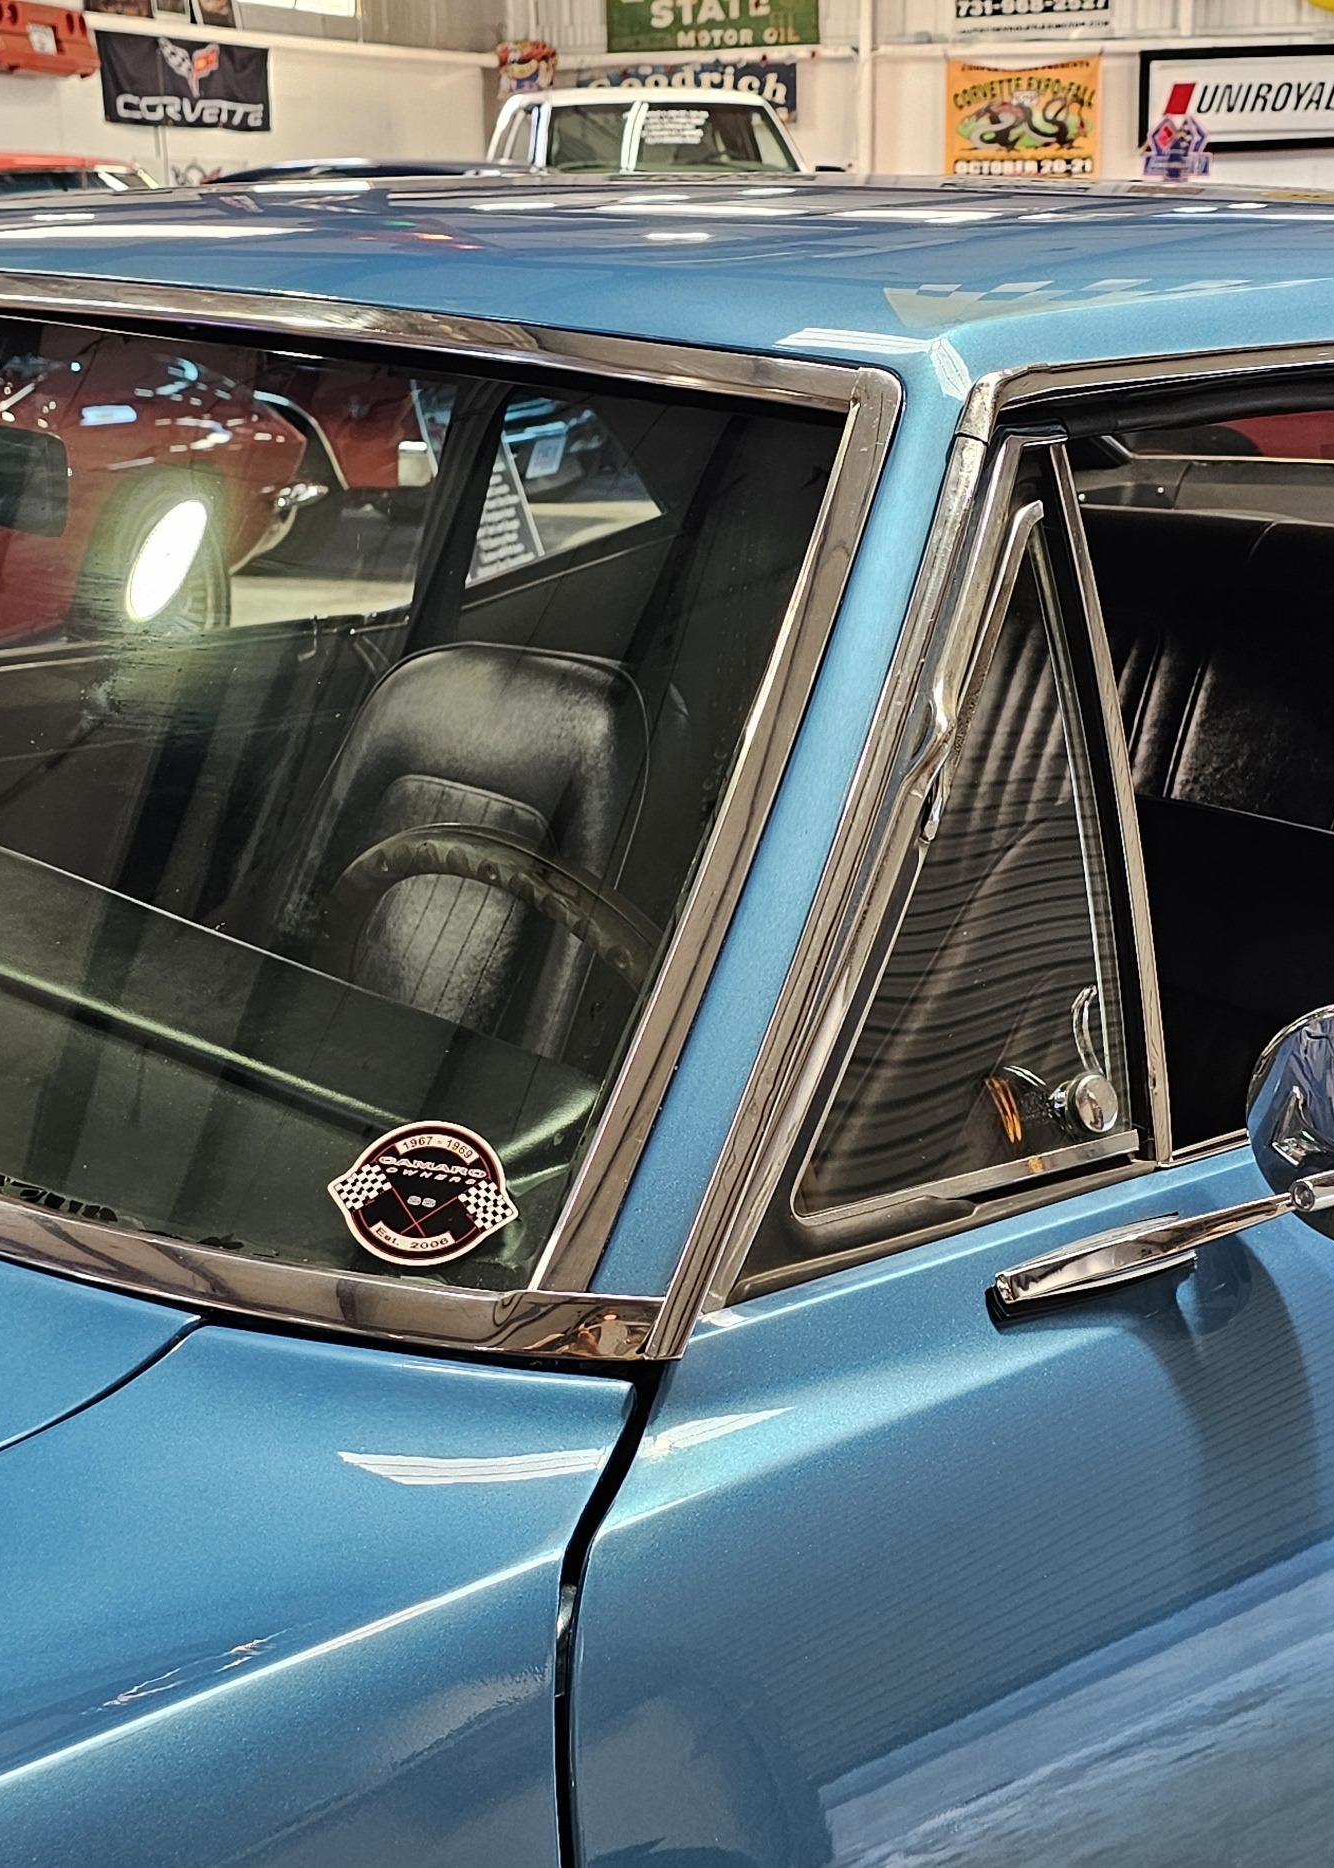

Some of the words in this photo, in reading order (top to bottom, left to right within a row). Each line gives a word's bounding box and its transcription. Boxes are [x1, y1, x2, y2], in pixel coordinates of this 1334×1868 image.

[677, 28, 753, 48] MOTOR
[762, 26, 800, 43] OIL
[953, 76, 1023, 110] CORVETTE
[116, 93, 264, 127] CORVETTE
[402, 1136, 433, 1151] 1967
[446, 1139, 474, 1160] 1969
[379, 1156, 487, 1178] CAMARO
[385, 1167, 477, 1186] OWNERS
[375, 1226, 400, 1247] Est.
[409, 1236, 450, 1250] 2006
